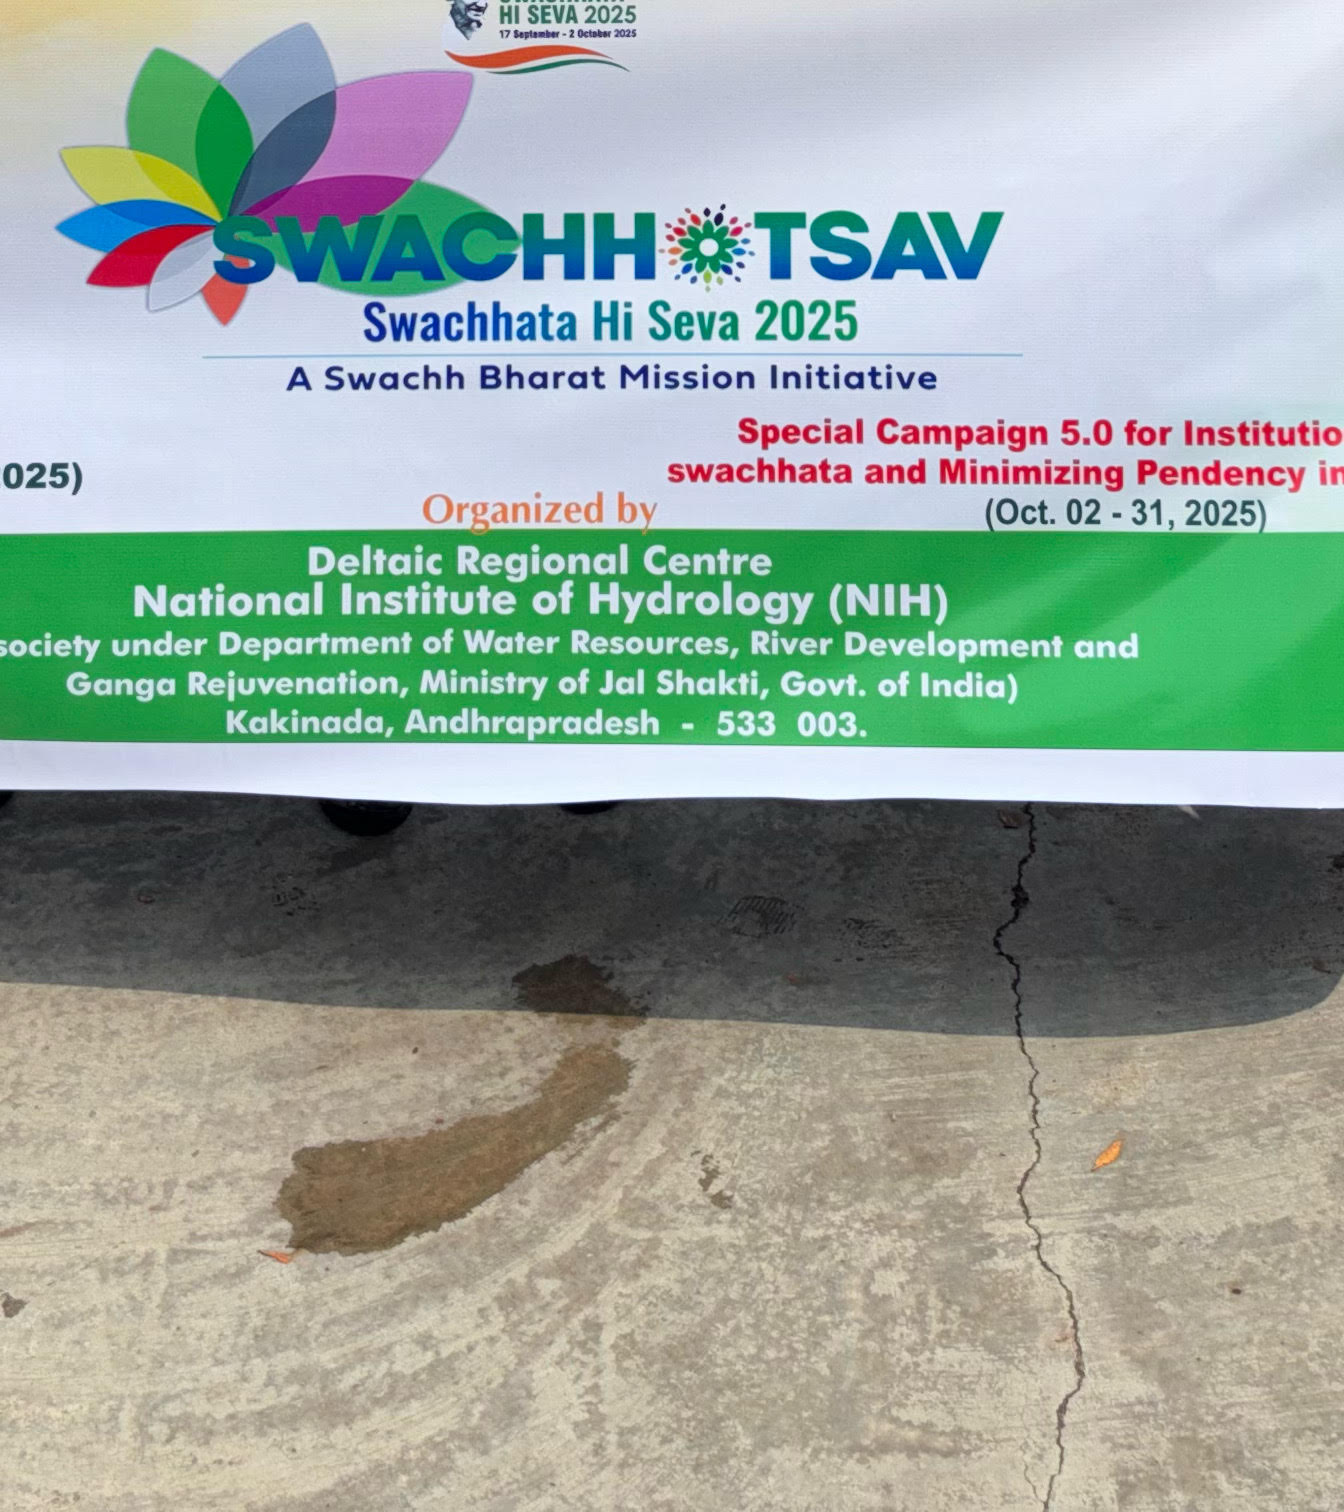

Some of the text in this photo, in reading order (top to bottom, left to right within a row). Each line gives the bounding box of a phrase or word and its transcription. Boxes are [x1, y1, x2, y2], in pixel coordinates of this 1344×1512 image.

[499, 5, 637, 24] HI SEVA 2025
[499, 30, 510, 38] 17
[513, 29, 559, 40] September
[569, 30, 575, 38] 2
[577, 29, 611, 38] October
[614, 29, 637, 38] 2025
[363, 300, 858, 342] Swachhata Hi Seva 2025
[287, 364, 939, 392] A Swachh Bharat Mission Initiative
[737, 417, 864, 450] Special
[876, 417, 1048, 450] Campaign
[1060, 419, 1113, 446] 5.0
[1124, 419, 1172, 446] for
[667, 458, 853, 484] swachhata
[864, 458, 927, 484] and
[939, 458, 1125, 493] Minimizing
[1137, 459, 1306, 493] Pendency
[422, 491, 658, 536] Organized by
[985, 498, 1056, 531] (Oct.
[1066, 498, 1102, 526] 02
[1131, 498, 1175, 530] 31,
[1184, 498, 1267, 531] 2025)
[308, 544, 773, 583] Deltaic Regional Centre
[133, 581, 949, 626] National Institute of Hydrology (NIH)
[111, 630, 208, 657] under
[218, 630, 413, 662] Department
[422, 629, 454, 655] of
[463, 629, 560, 656] Water
[571, 631, 739, 660] Resources,
[750, 630, 833, 657] River
[844, 631, 1063, 664] Development
[1074, 633, 1140, 660] and
[66, 669, 1019, 705] Ganga Rejuvenation, Ministry of Jal Shakti, Govt. of India)
[225, 709, 394, 738] Kakinada,
[403, 709, 660, 742] Andhrapradesh
[716, 712, 777, 737] 533
[797, 712, 868, 738] 003.
